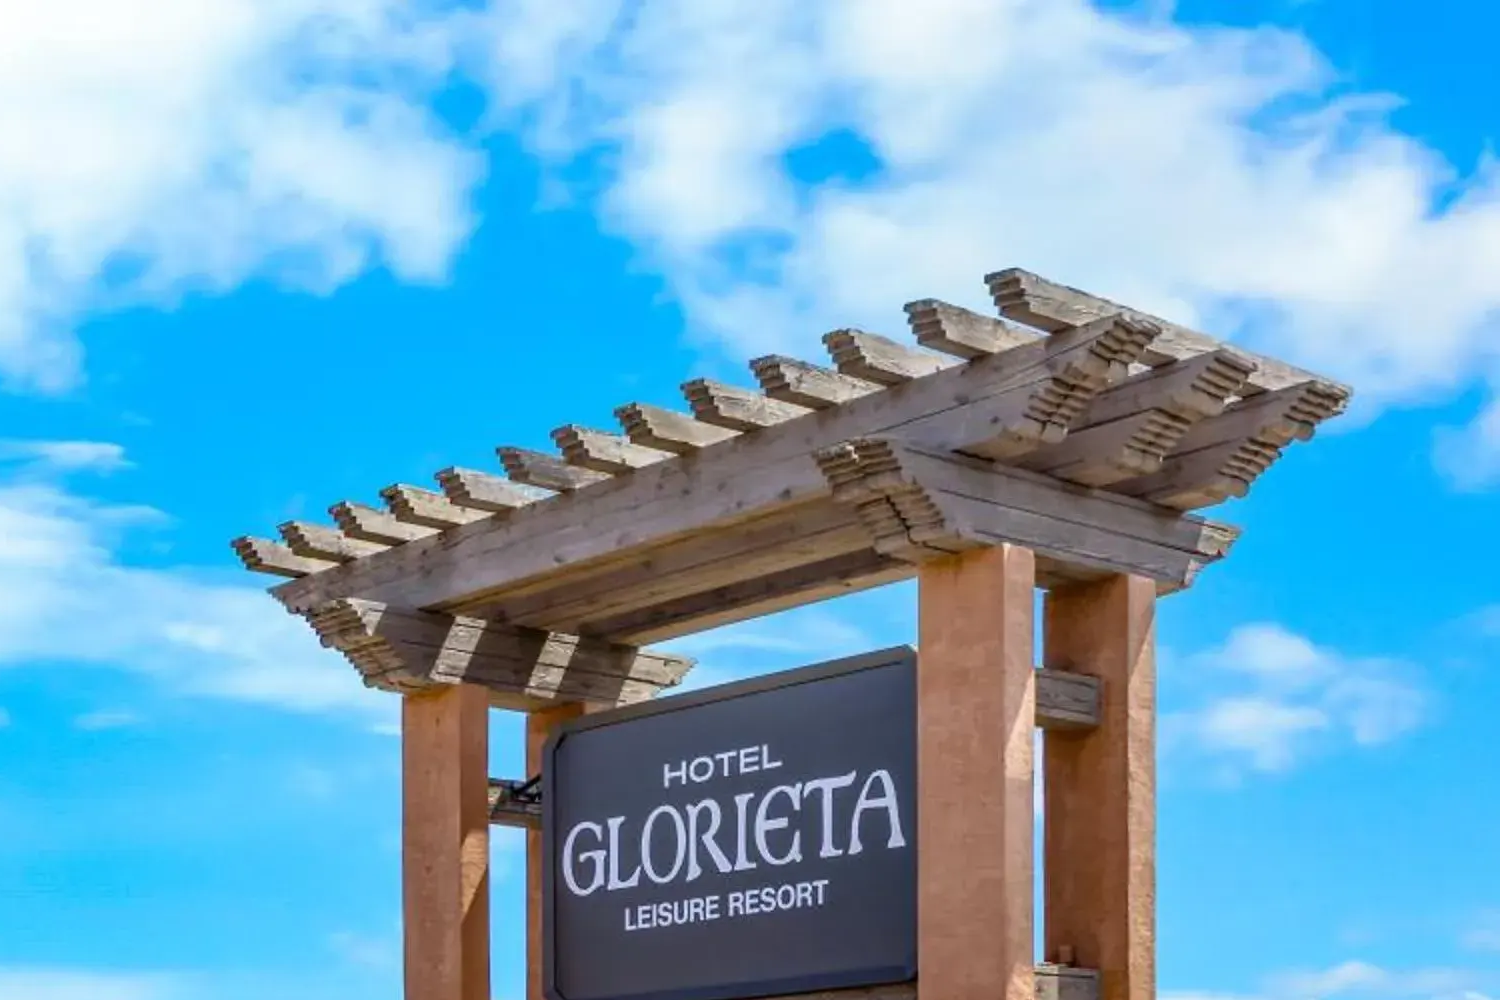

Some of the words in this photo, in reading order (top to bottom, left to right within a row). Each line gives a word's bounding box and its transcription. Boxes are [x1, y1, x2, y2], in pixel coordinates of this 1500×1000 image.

[663, 744, 782, 788] HOTEL
[562, 769, 906, 896] GLORIETA
[624, 896, 720, 931] LEISURE
[728, 880, 829, 917] RESORT
